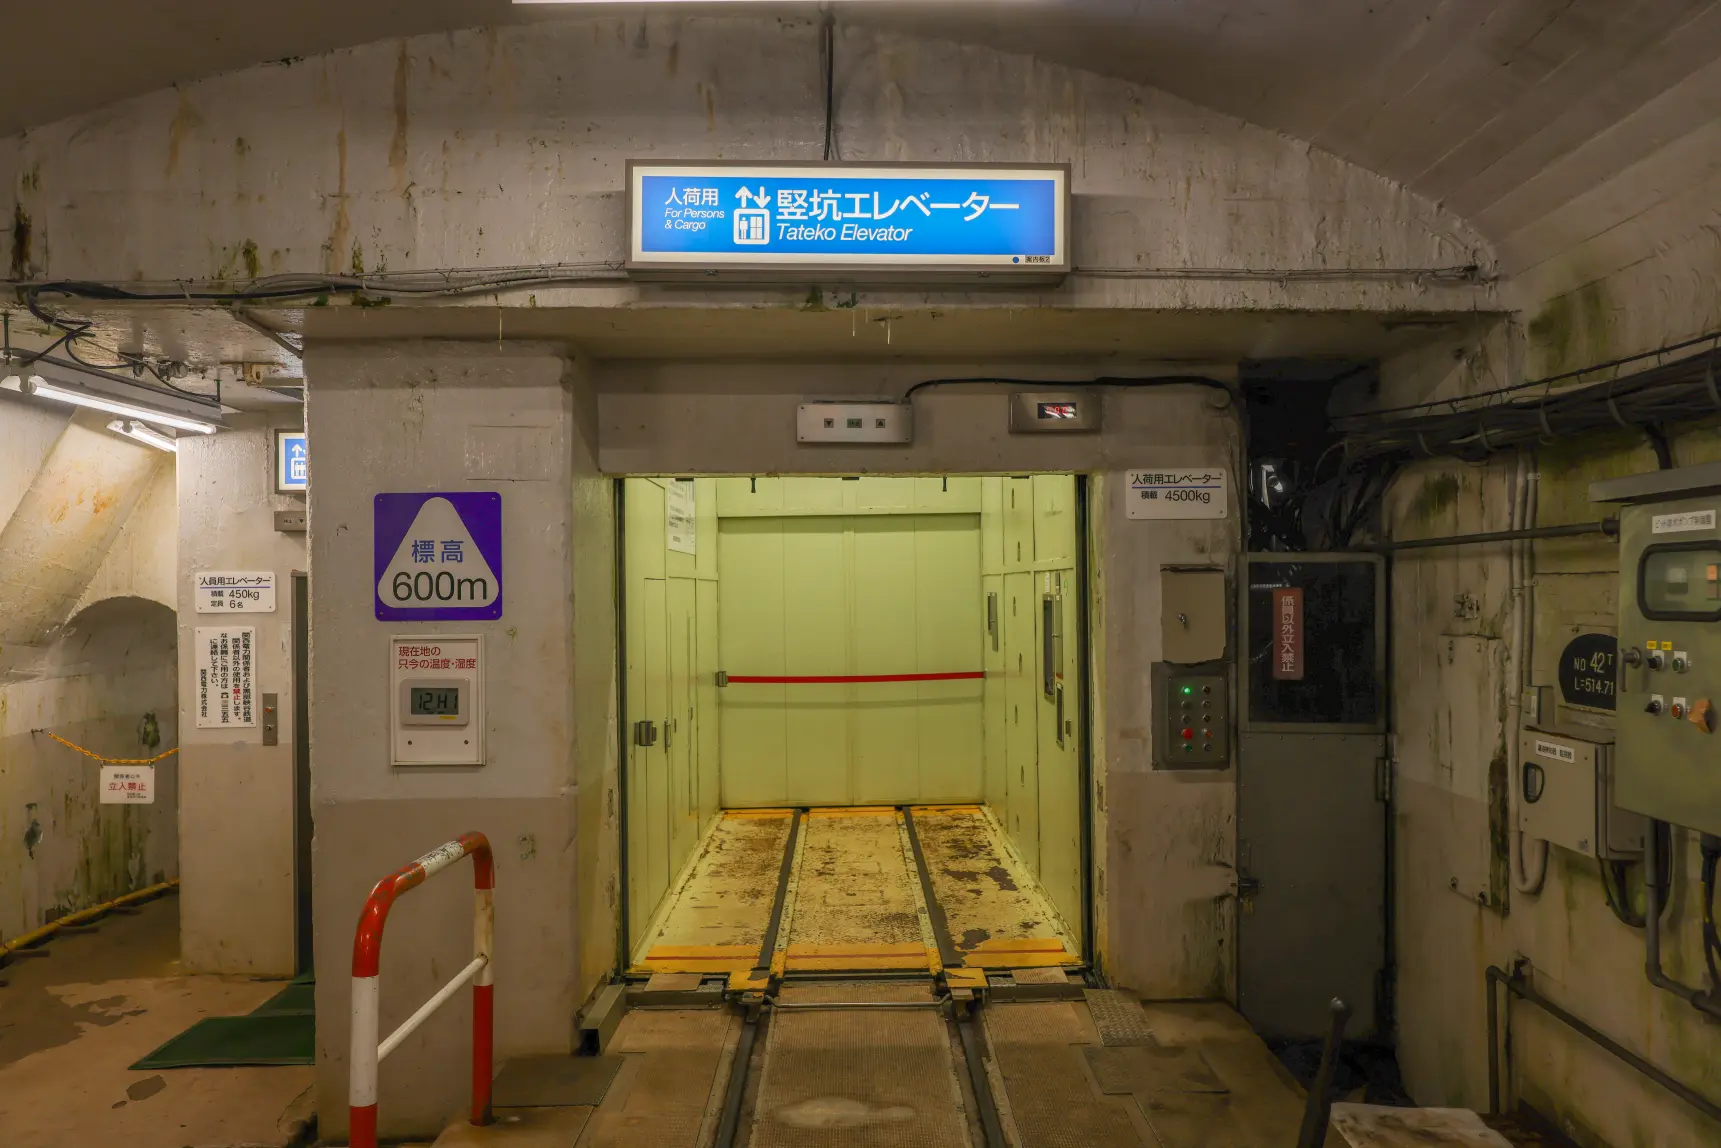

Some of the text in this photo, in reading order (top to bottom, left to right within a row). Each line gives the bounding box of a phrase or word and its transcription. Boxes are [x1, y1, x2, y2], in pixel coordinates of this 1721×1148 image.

[664, 187, 719, 206] 人荷用
[776, 189, 1019, 222] 竪坑エレベーター
[664, 208, 725, 219] For Persons
[664, 219, 706, 232] & Cargo
[776, 223, 913, 242] Tateko Elevator
[1132, 473, 1221, 485] 人荷用エレベーター
[1164, 489, 1211, 504] 4500kg
[411, 539, 464, 564] 標高
[200, 576, 271, 586] 人員用エレベーター
[392, 571, 487, 602] 600m
[229, 589, 260, 601] 450kg
[229, 600, 243, 609] 6名
[398, 646, 441, 657] 現在地の
[398, 658, 477, 669] 只今の温度・湿度
[1574, 676, 1614, 696] L=514.71
[108, 782, 147, 791] 立入禁止
